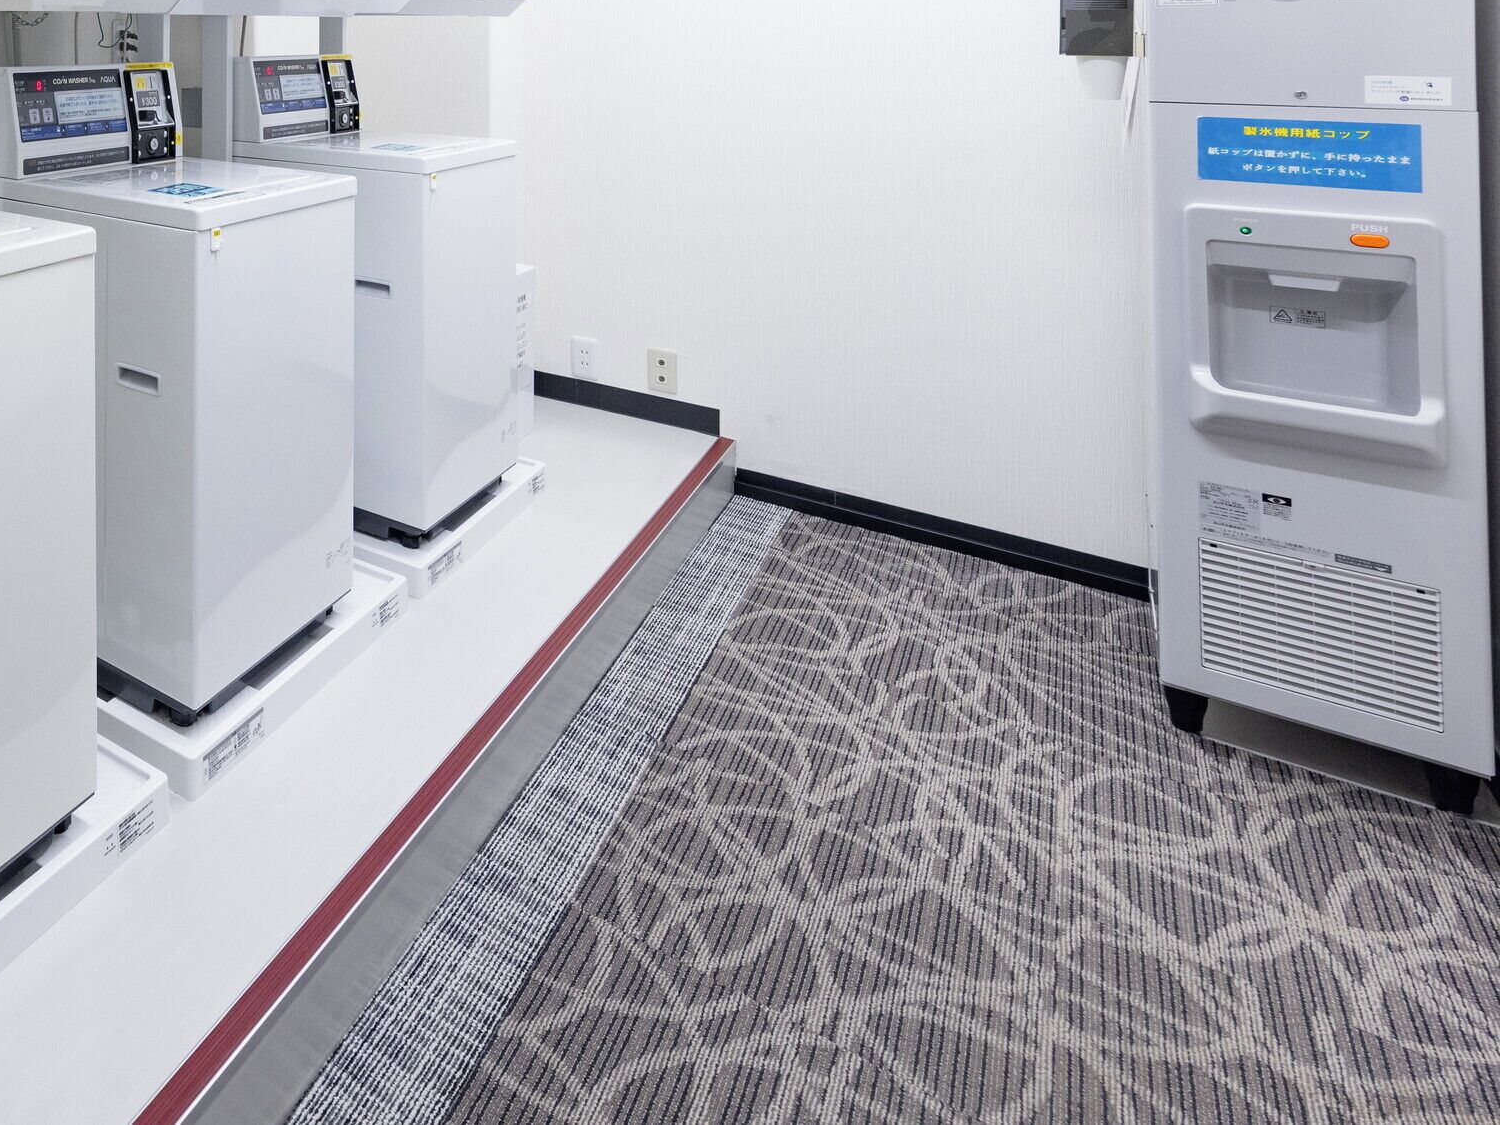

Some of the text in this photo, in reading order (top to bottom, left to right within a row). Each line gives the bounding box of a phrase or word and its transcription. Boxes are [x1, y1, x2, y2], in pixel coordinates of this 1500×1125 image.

[1242, 125, 1371, 140] 製氷機用紙コップ
[1207, 146, 1411, 166] 紙コップは置かずに、手に持ったまま
[1242, 163, 1367, 178] ボタンを押して下さい。
[1350, 223, 1389, 234] PUSH
